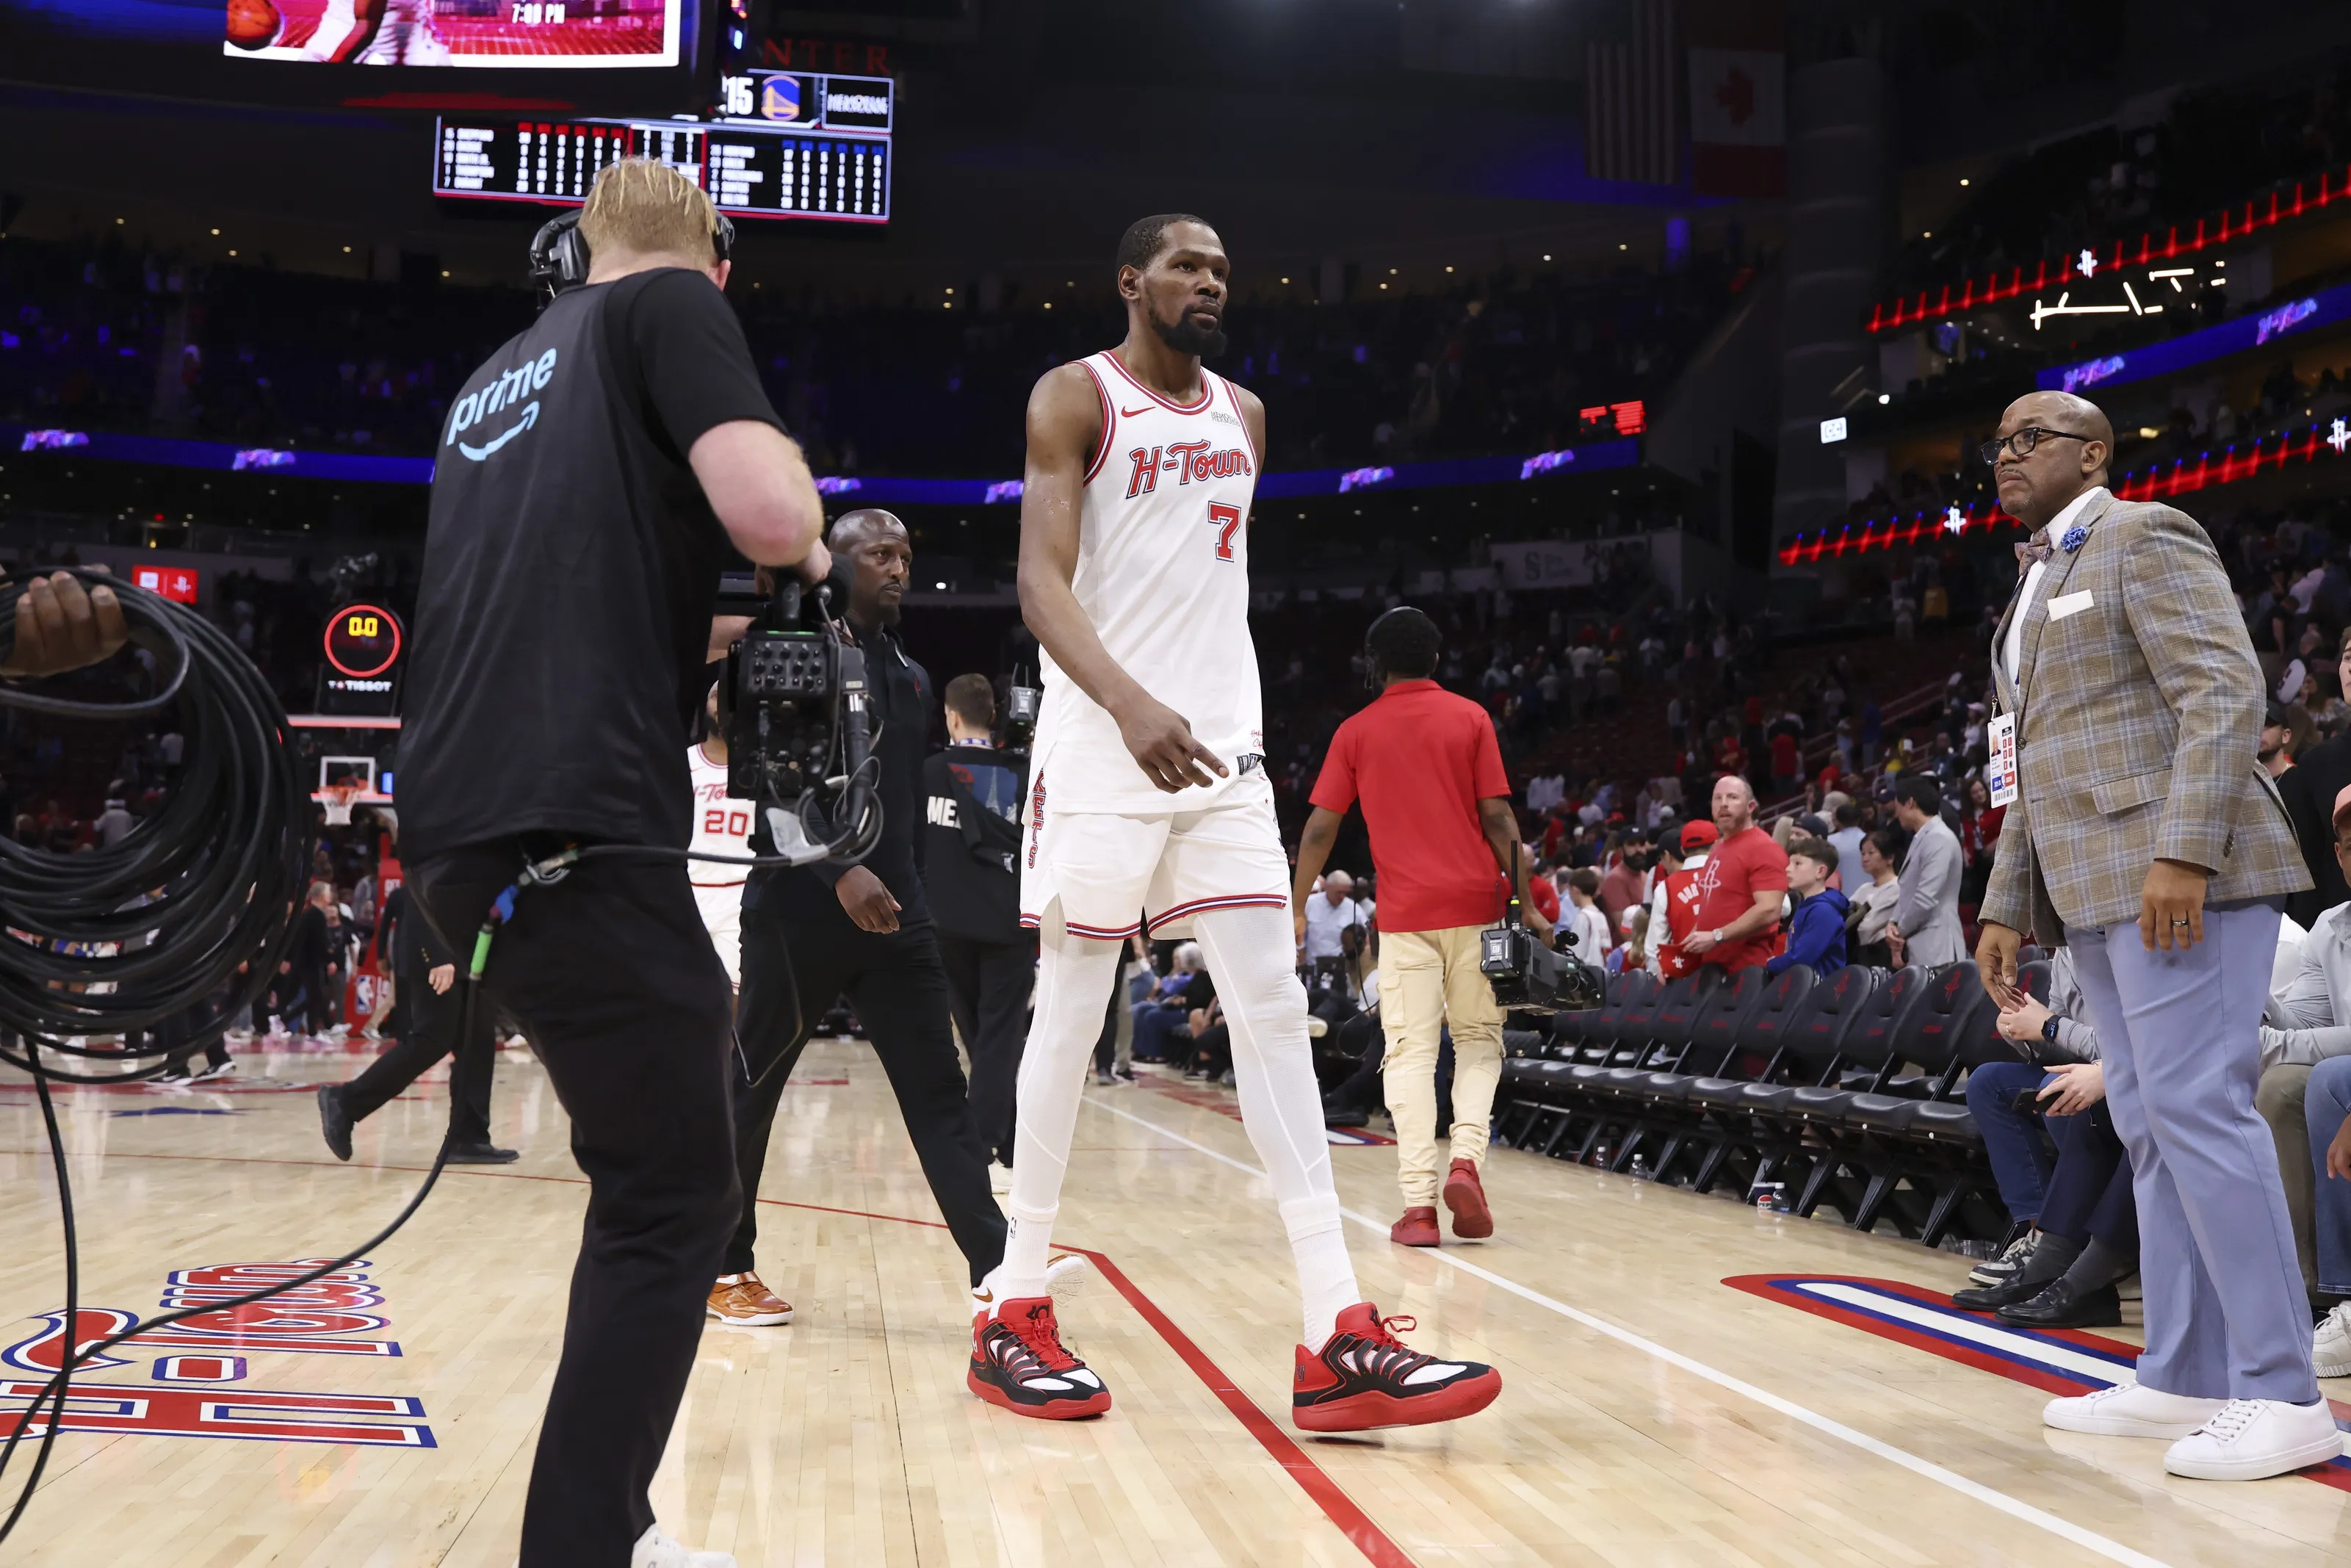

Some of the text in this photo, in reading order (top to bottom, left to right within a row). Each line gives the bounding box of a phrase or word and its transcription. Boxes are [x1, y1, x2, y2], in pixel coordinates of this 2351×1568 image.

[545, 3, 566, 24] PM
[1125, 438, 1252, 499] H-Town
[1208, 500, 1242, 563] 7
[704, 809, 750, 837] 20
